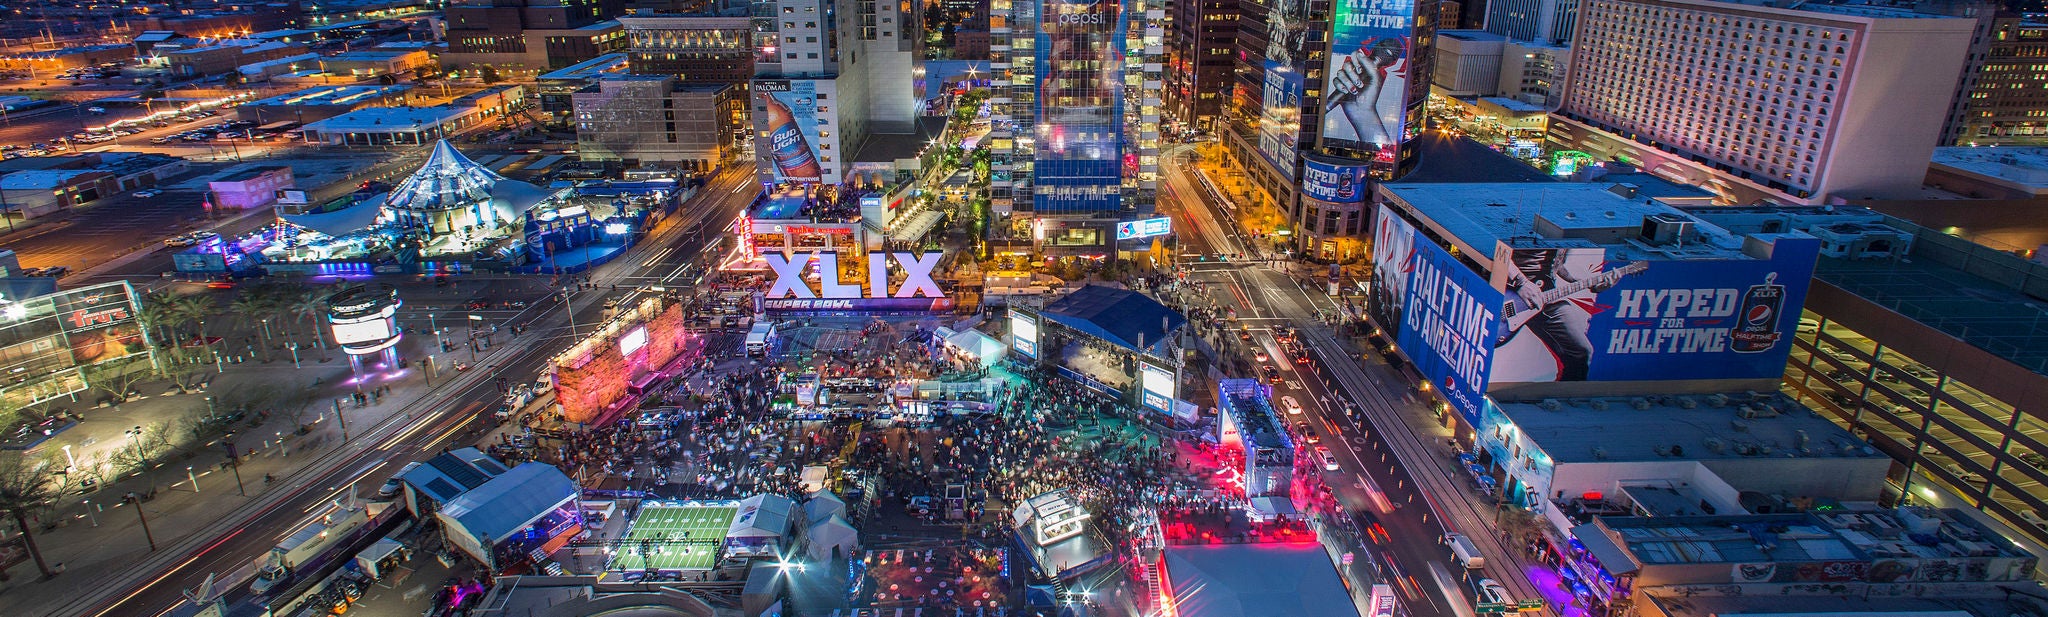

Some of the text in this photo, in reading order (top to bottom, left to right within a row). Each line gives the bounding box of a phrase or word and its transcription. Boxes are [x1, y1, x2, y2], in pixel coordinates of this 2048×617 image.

[1059, 11, 1103, 27] pepsi
[1343, 13, 1405, 30] HALFTIME
[772, 135, 800, 151] LIGHT
[774, 129, 797, 144] BUD
[1047, 187, 1108, 200] #HALFTIME
[763, 250, 946, 298] XLIX
[764, 300, 811, 309] SUPER
[812, 300, 854, 309] BOWL
[1412, 254, 1495, 357] HALFTIME
[1615, 288, 1740, 318] HYPED
[1659, 318, 1685, 328] FOR
[1607, 328, 1730, 354] HALFTIME
[1735, 332, 1773, 340] HALFTIME
[1407, 294, 1487, 395] IS AMAZING
[1454, 388, 1478, 418] pepsi
